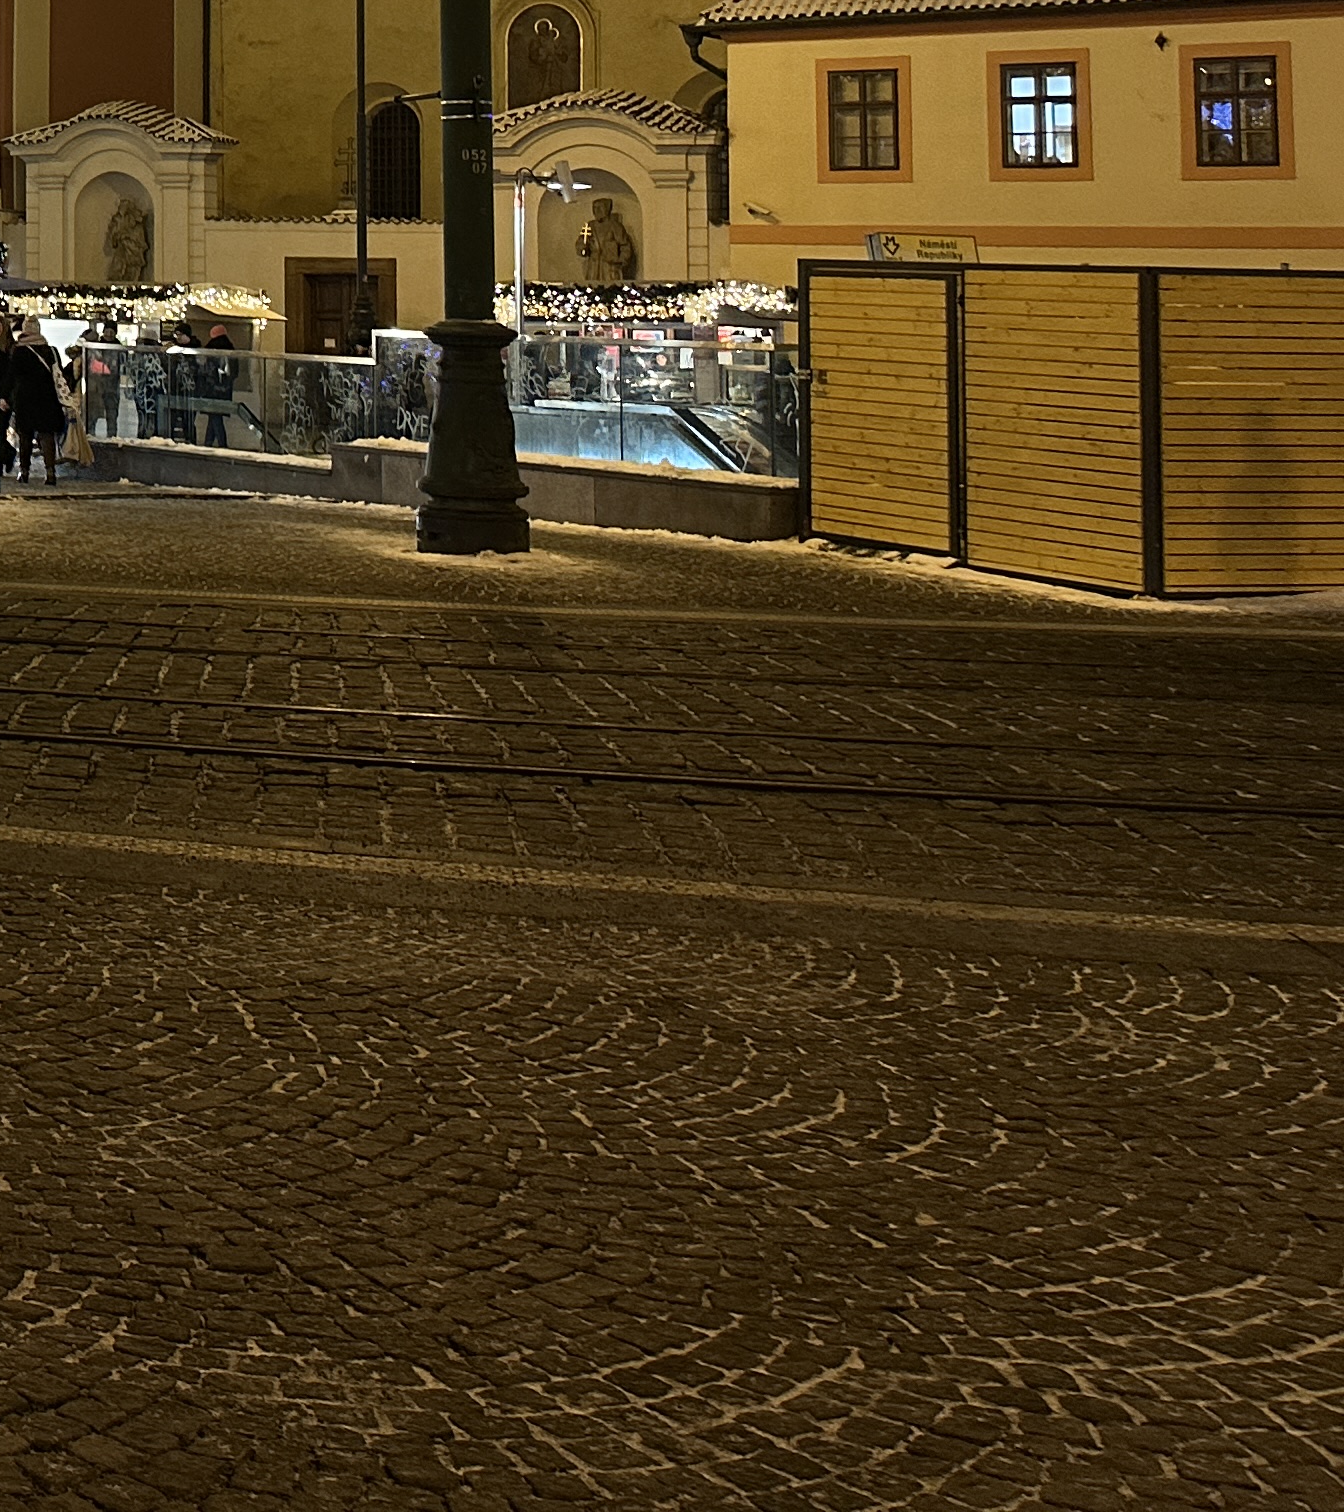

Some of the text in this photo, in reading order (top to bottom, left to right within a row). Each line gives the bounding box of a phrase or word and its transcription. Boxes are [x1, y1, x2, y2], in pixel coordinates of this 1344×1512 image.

[462, 148, 486, 161] 052
[472, 162, 487, 174] 07
[919, 239, 957, 249] Náměstí
[916, 250, 963, 261] Republiky
